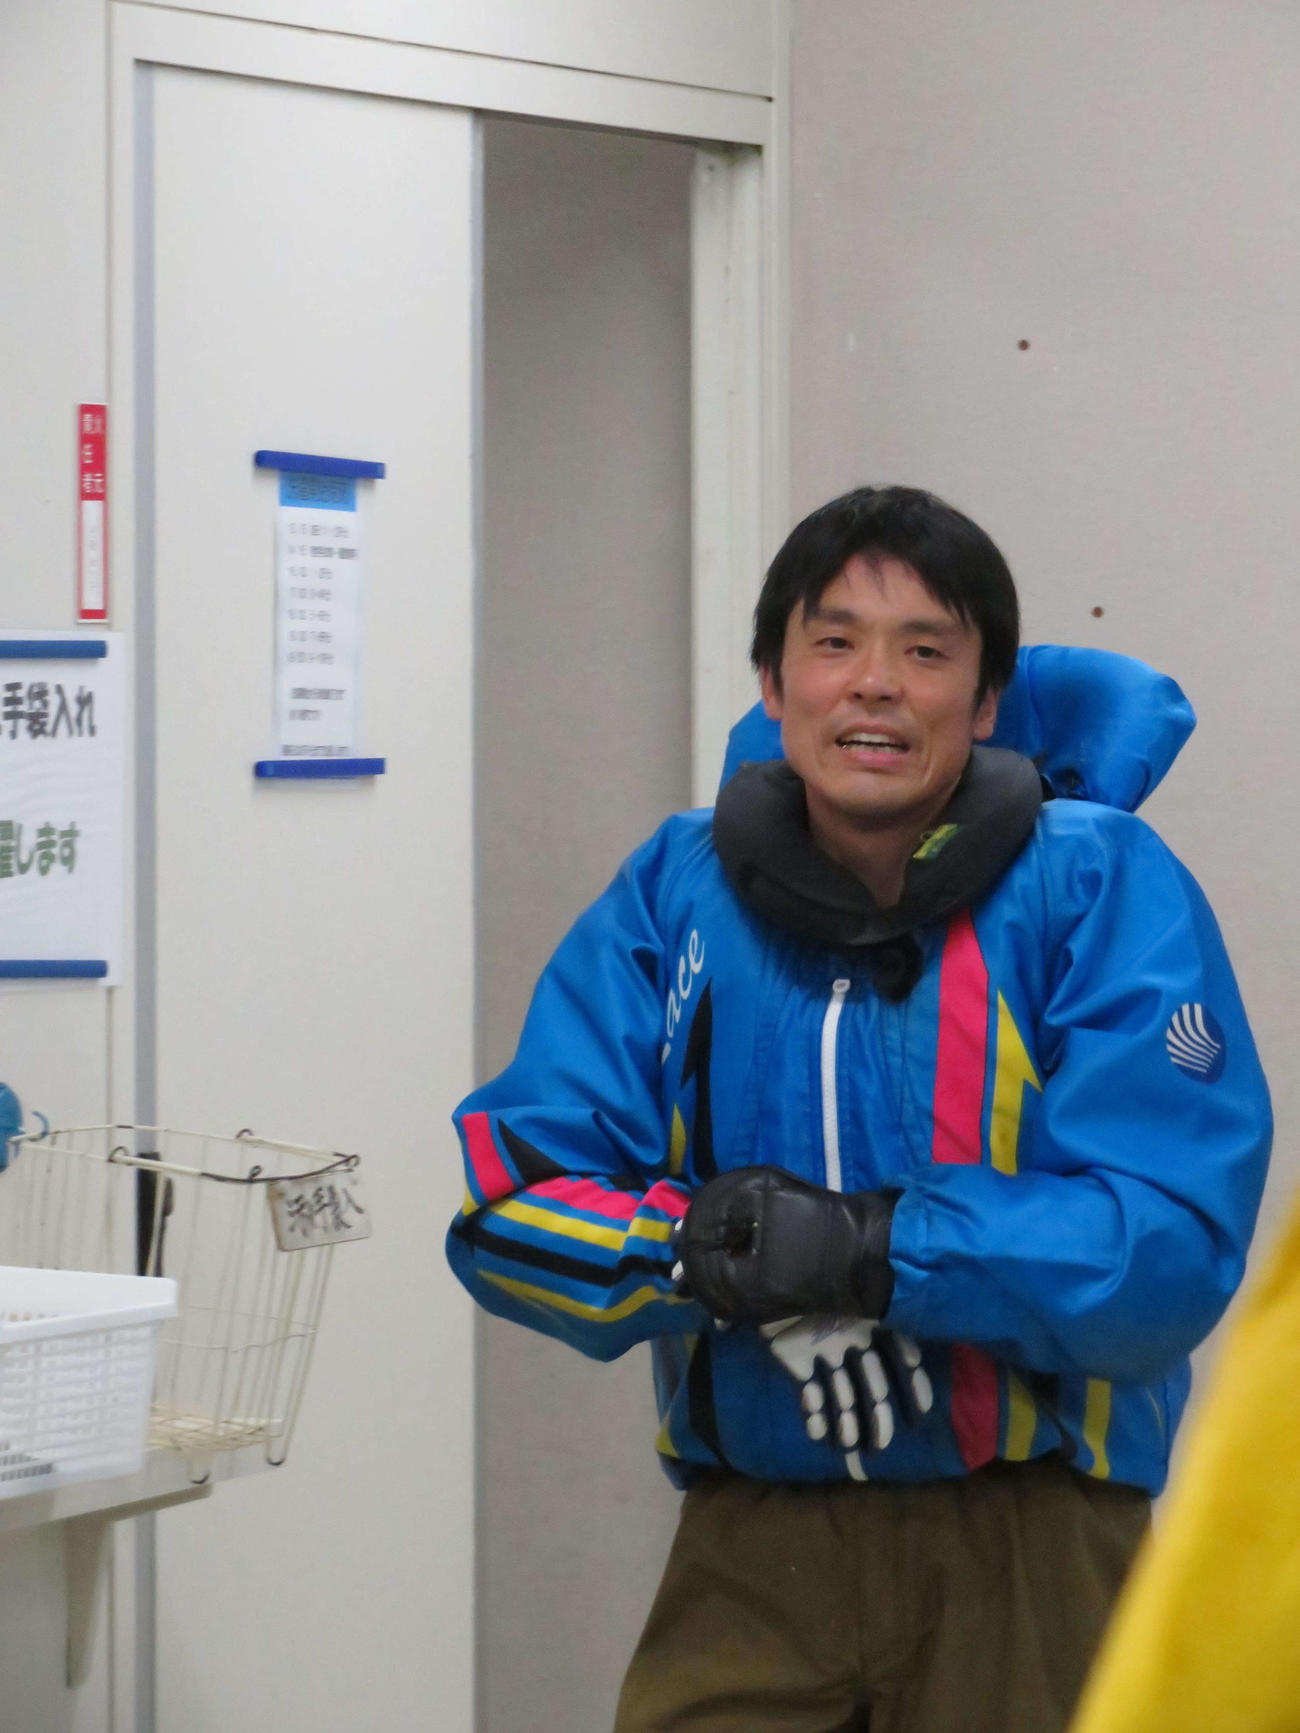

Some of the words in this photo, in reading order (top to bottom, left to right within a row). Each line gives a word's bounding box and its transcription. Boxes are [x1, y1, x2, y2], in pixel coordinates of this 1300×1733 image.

[0, 681, 96, 741] 手袋入れ
[661, 929, 705, 1065] ace
